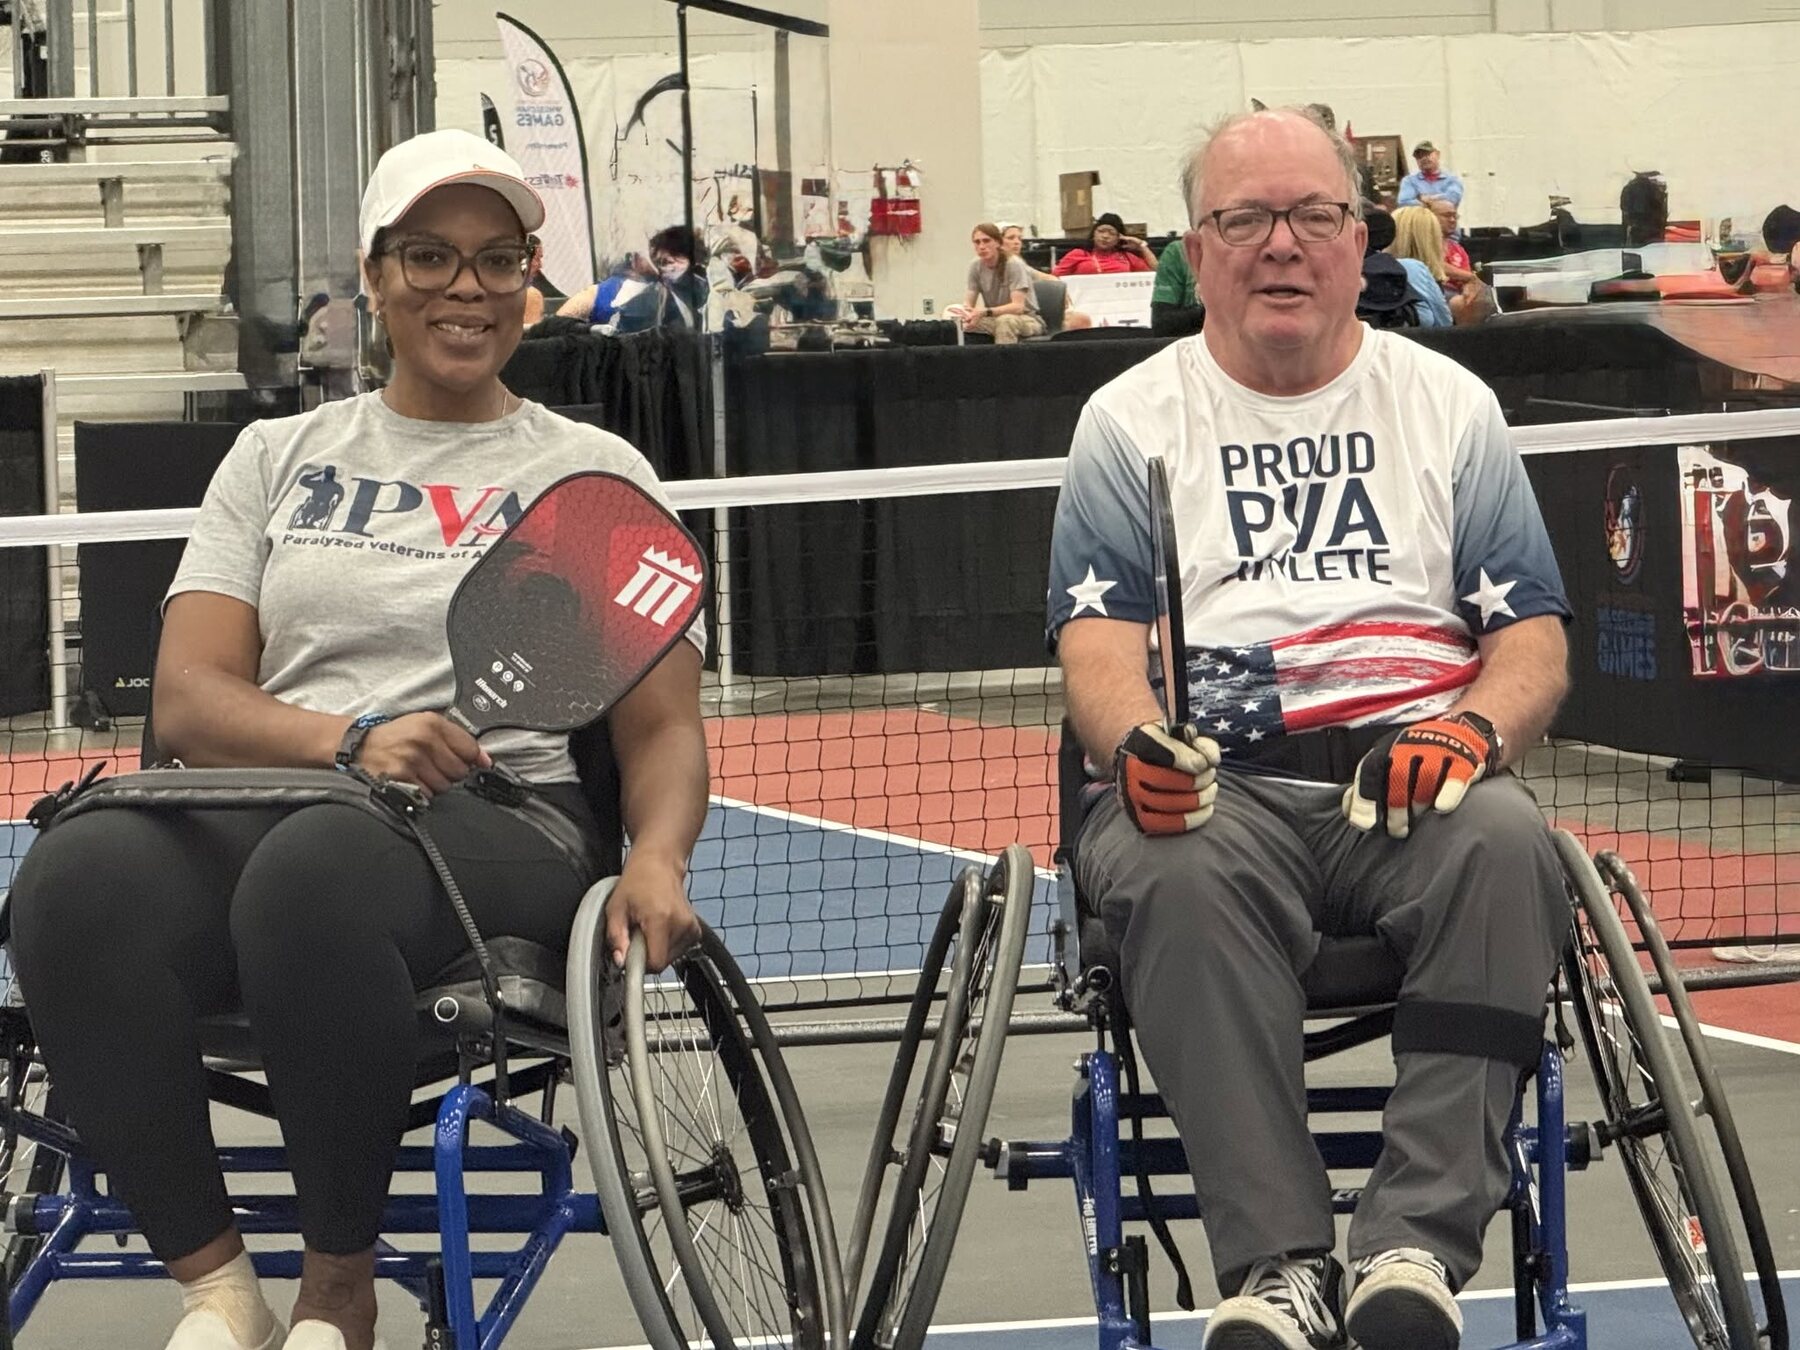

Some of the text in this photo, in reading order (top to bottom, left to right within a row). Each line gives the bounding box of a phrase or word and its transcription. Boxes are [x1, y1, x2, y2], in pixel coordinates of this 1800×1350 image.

[1220, 431, 1376, 487] PROUD
[332, 477, 523, 548] PVA
[1226, 477, 1390, 557] PVA
[283, 534, 365, 549] Paralyzed
[450, 549, 468, 559] of
